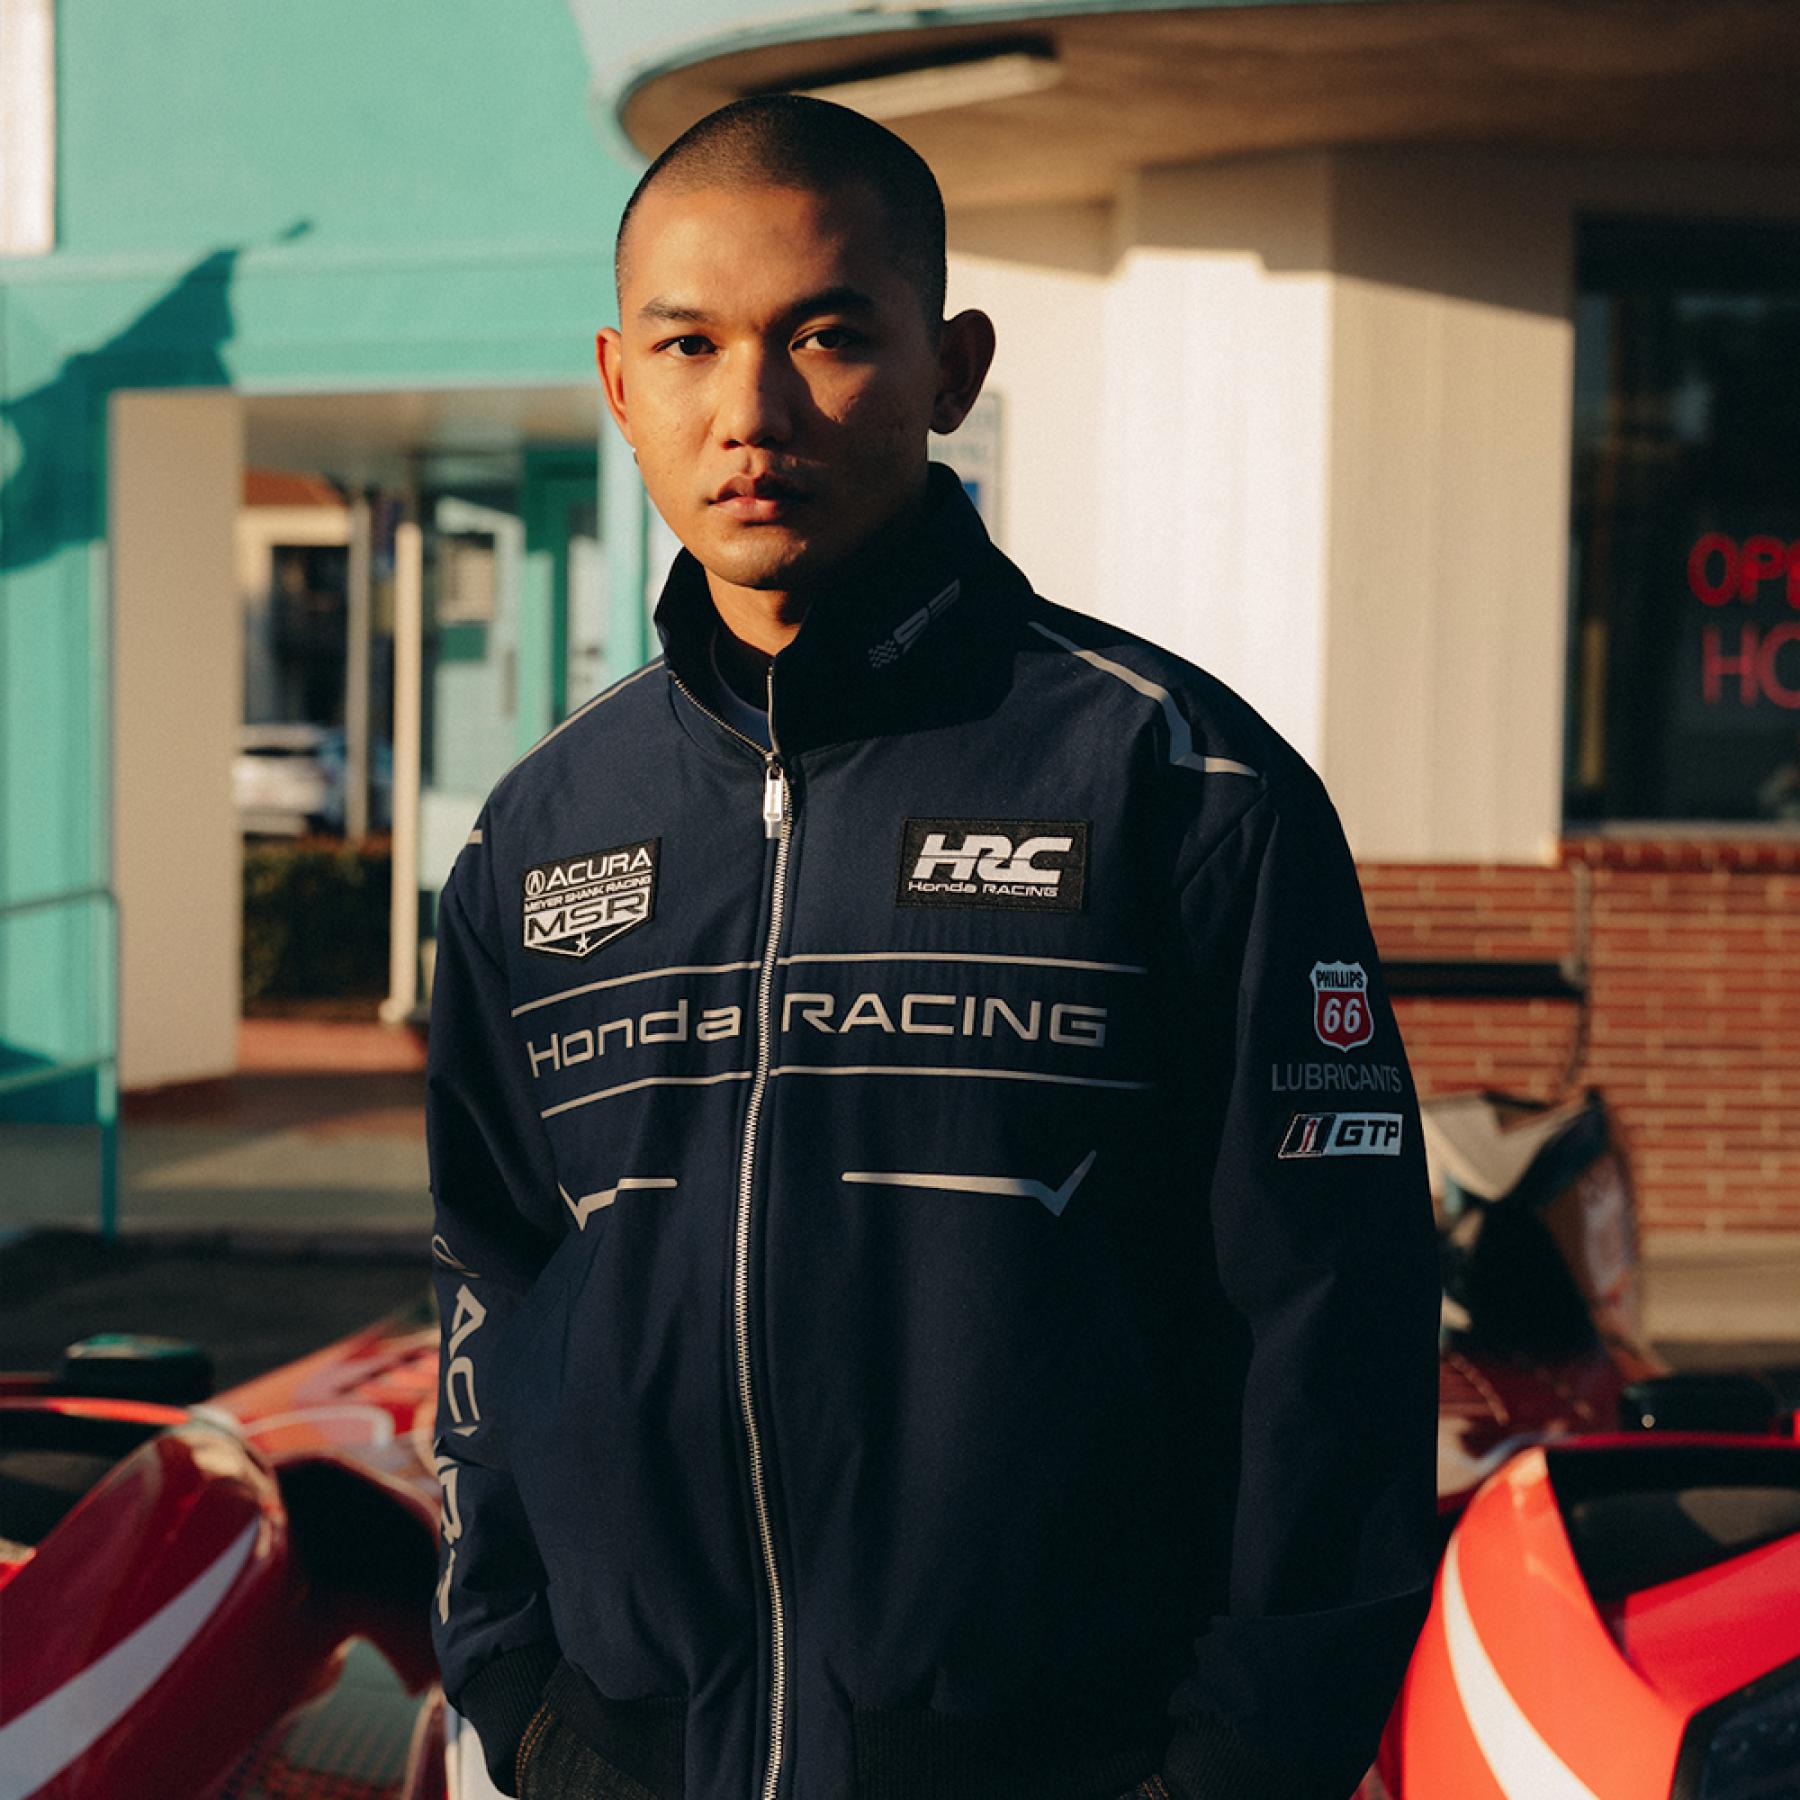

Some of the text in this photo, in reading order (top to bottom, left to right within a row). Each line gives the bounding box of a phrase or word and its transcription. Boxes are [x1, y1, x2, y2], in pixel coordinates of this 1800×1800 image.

[546, 847, 653, 891] ACURA
[911, 833, 1074, 885] HRC
[606, 875, 653, 893] RACING
[908, 881, 1059, 897] Honda RACING
[528, 892, 646, 941] MSR
[1315, 969, 1364, 989] PHILLIPS
[1322, 997, 1362, 1034] 66
[526, 992, 1108, 1079] Honda RACING
[1271, 1063, 1402, 1093] LUBRICANTS
[1333, 1119, 1400, 1148] GTP
